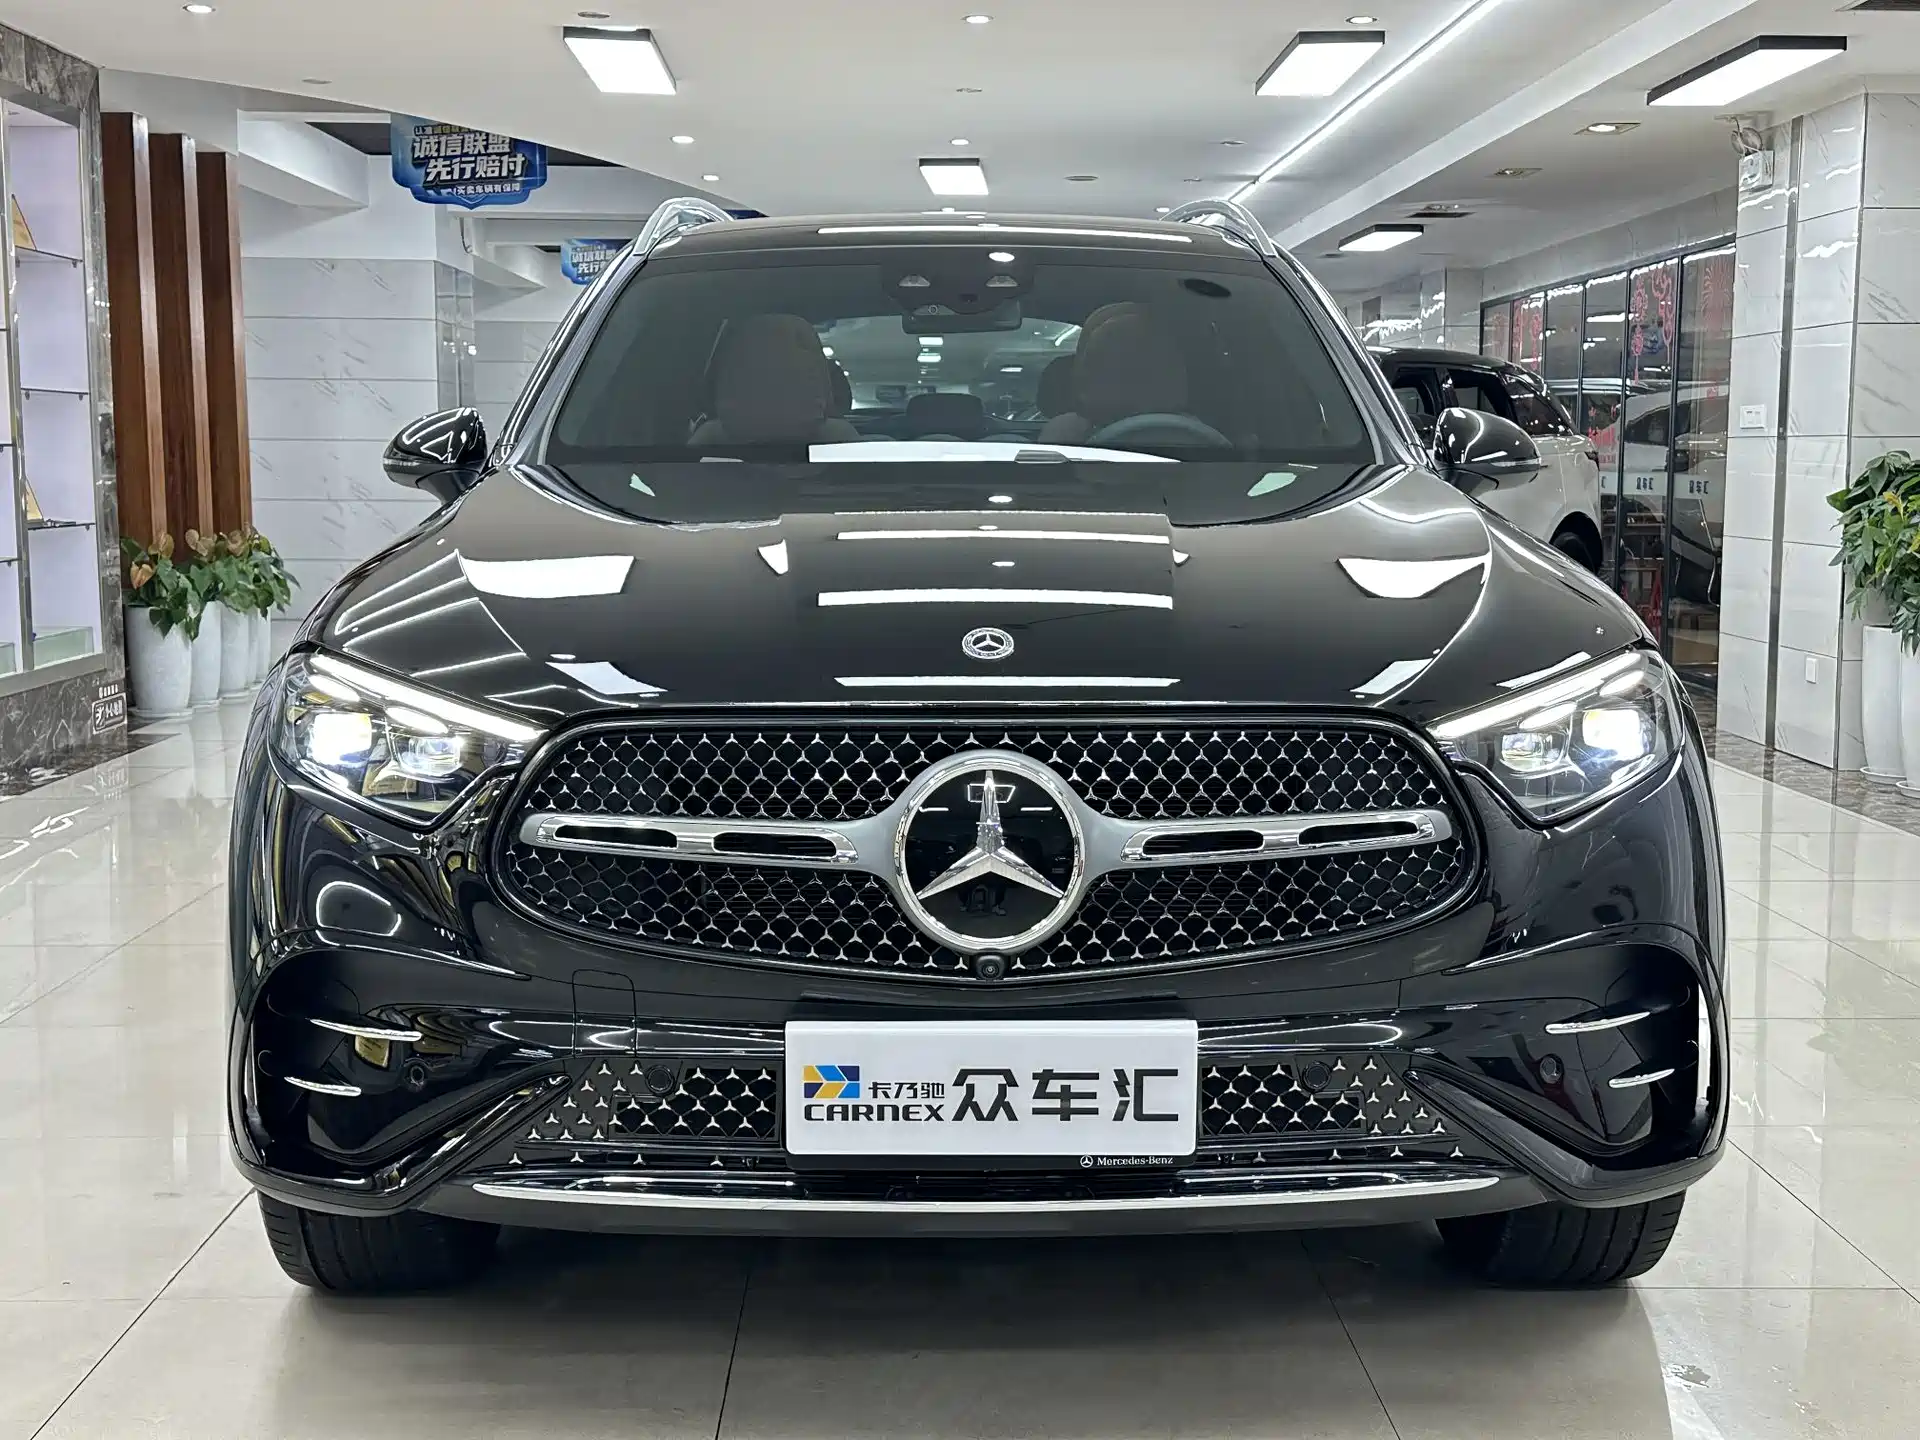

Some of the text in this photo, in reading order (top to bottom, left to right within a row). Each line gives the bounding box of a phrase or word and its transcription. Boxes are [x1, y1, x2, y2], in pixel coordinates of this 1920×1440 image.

[413, 132, 511, 159] 诚信联盟
[426, 153, 526, 182] 先行赔付
[868, 1081, 945, 1100] 卡乃驰
[951, 1067, 1179, 1122] 众车汇
[803, 1103, 945, 1122] CARNEX
[1096, 1155, 1174, 1167] Mercedes-Benz
